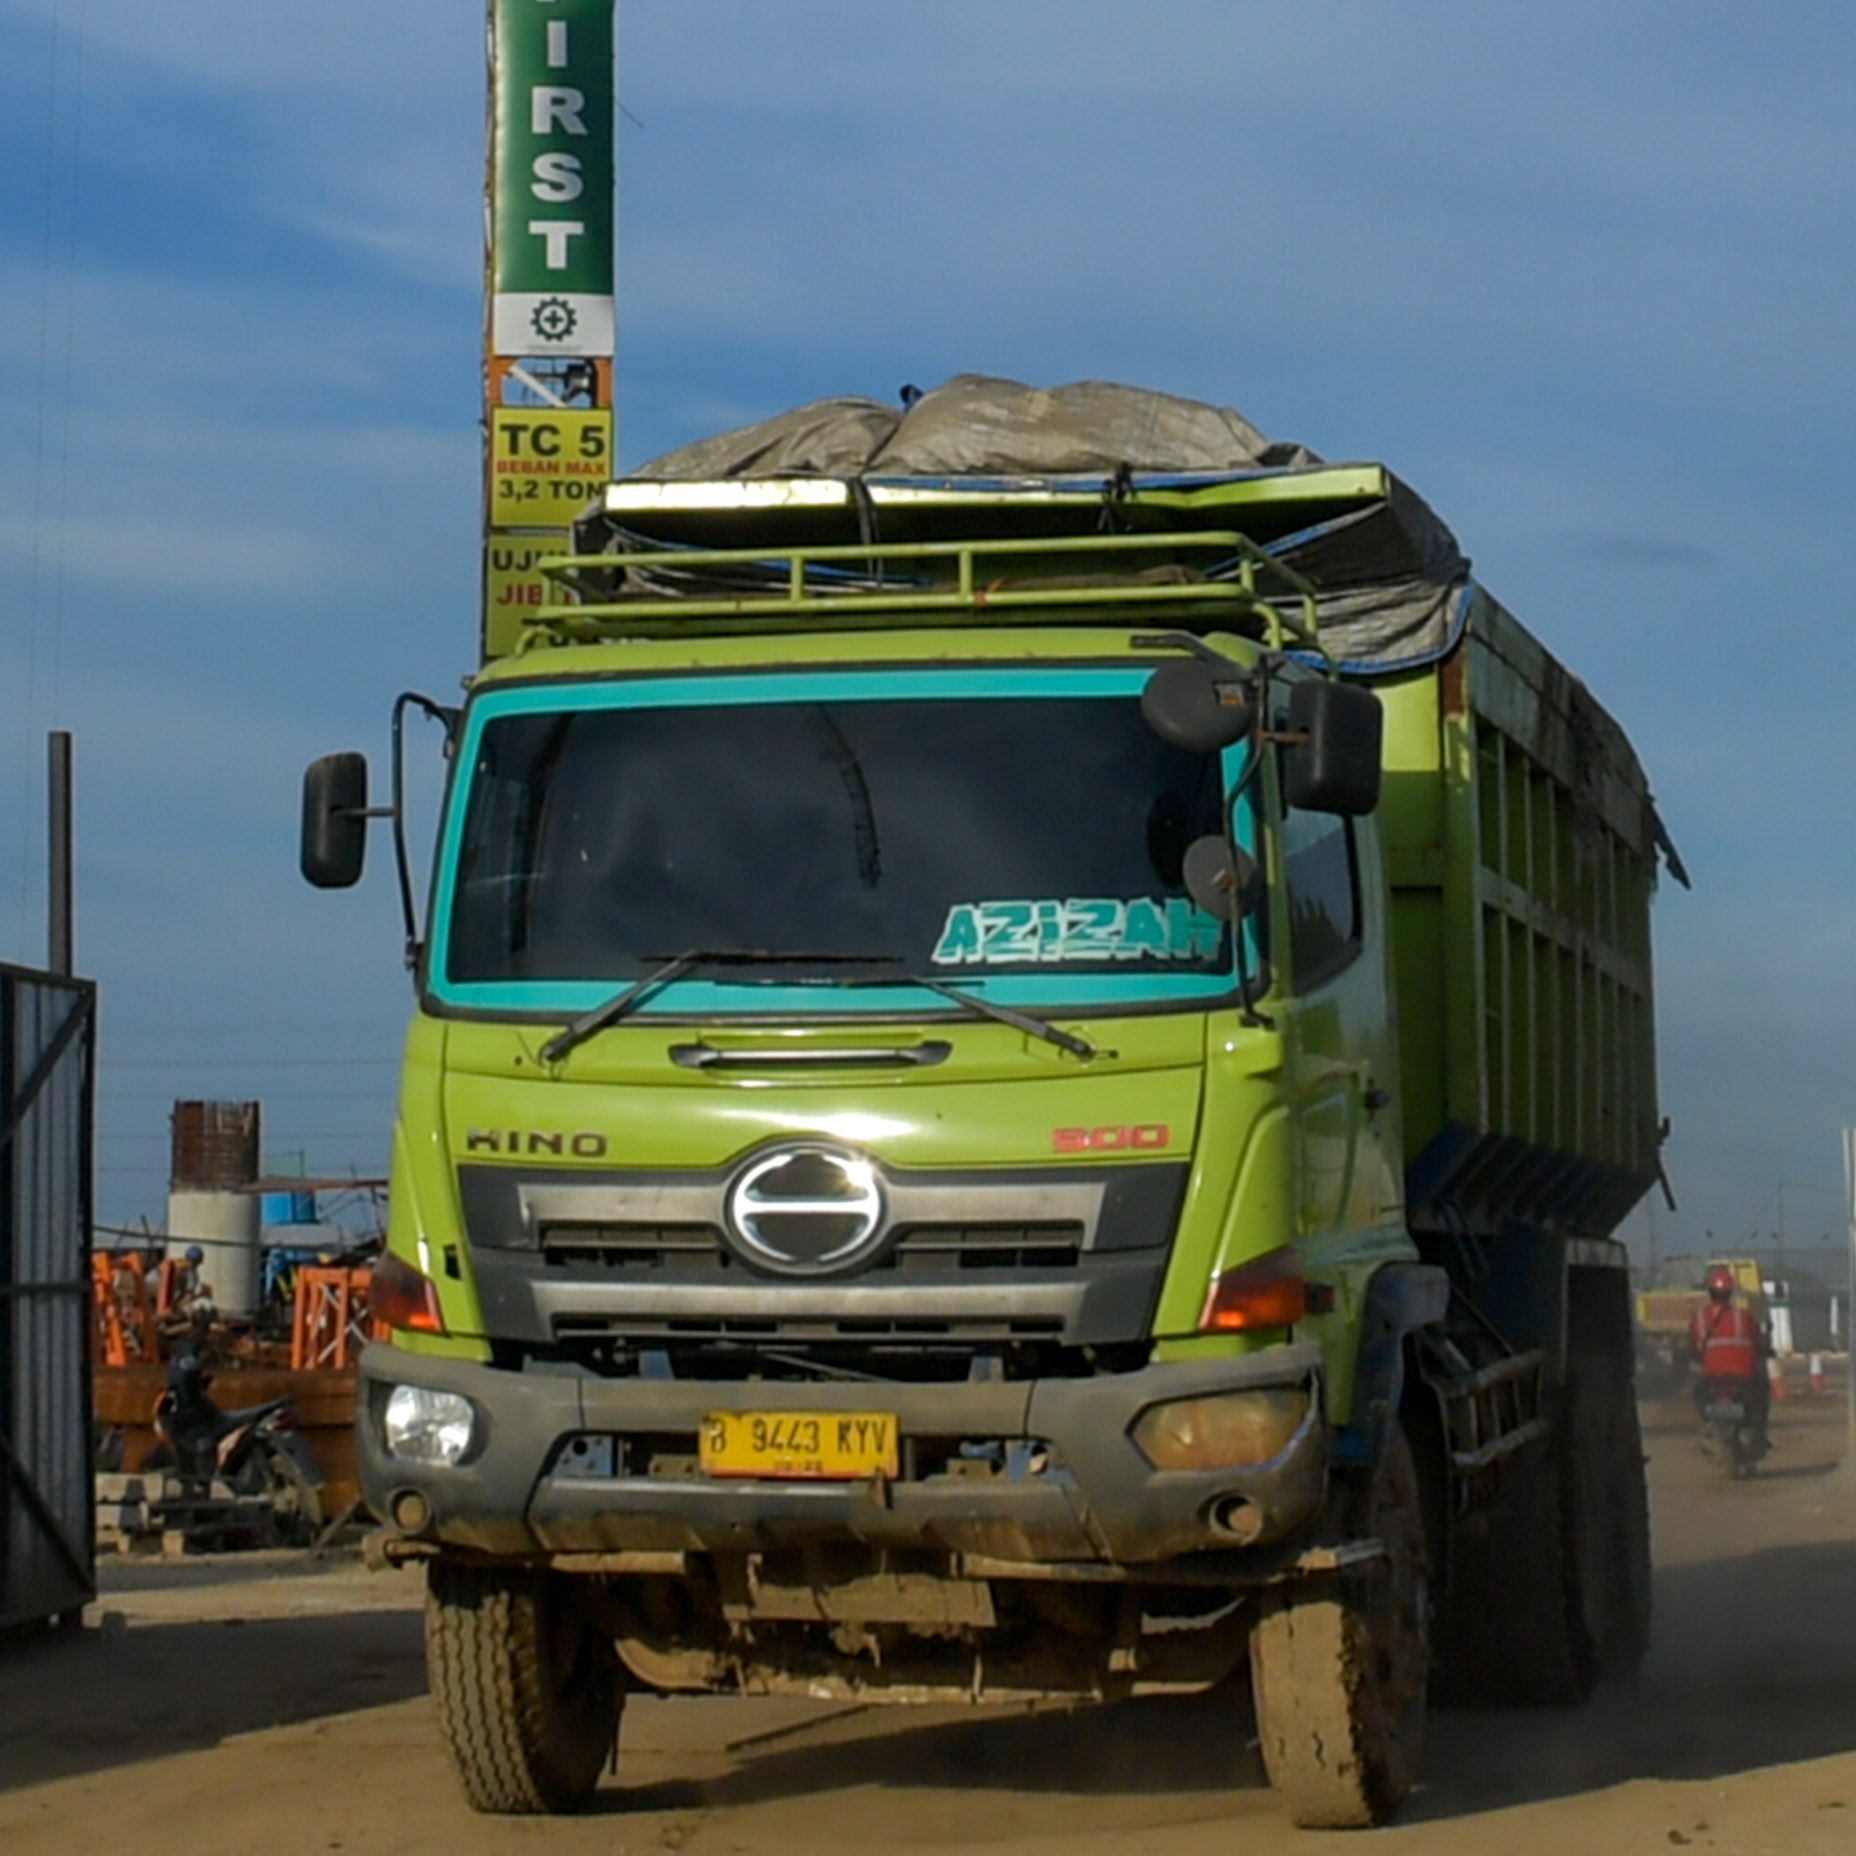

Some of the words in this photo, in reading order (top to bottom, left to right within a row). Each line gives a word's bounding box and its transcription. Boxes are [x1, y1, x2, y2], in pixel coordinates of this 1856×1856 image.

[499, 423, 561, 457] TC
[579, 425, 605, 458] 5
[497, 460, 559, 475] BEBAN
[566, 461, 606, 476] MAX
[499, 479, 539, 503] 3,2
[549, 480, 603, 501] TON
[496, 583, 543, 607] JIB
[467, 1129, 608, 1157] HINO
[709, 1418, 726, 1453] B
[751, 1418, 820, 1453] 9443
[837, 1420, 887, 1455] KYV
